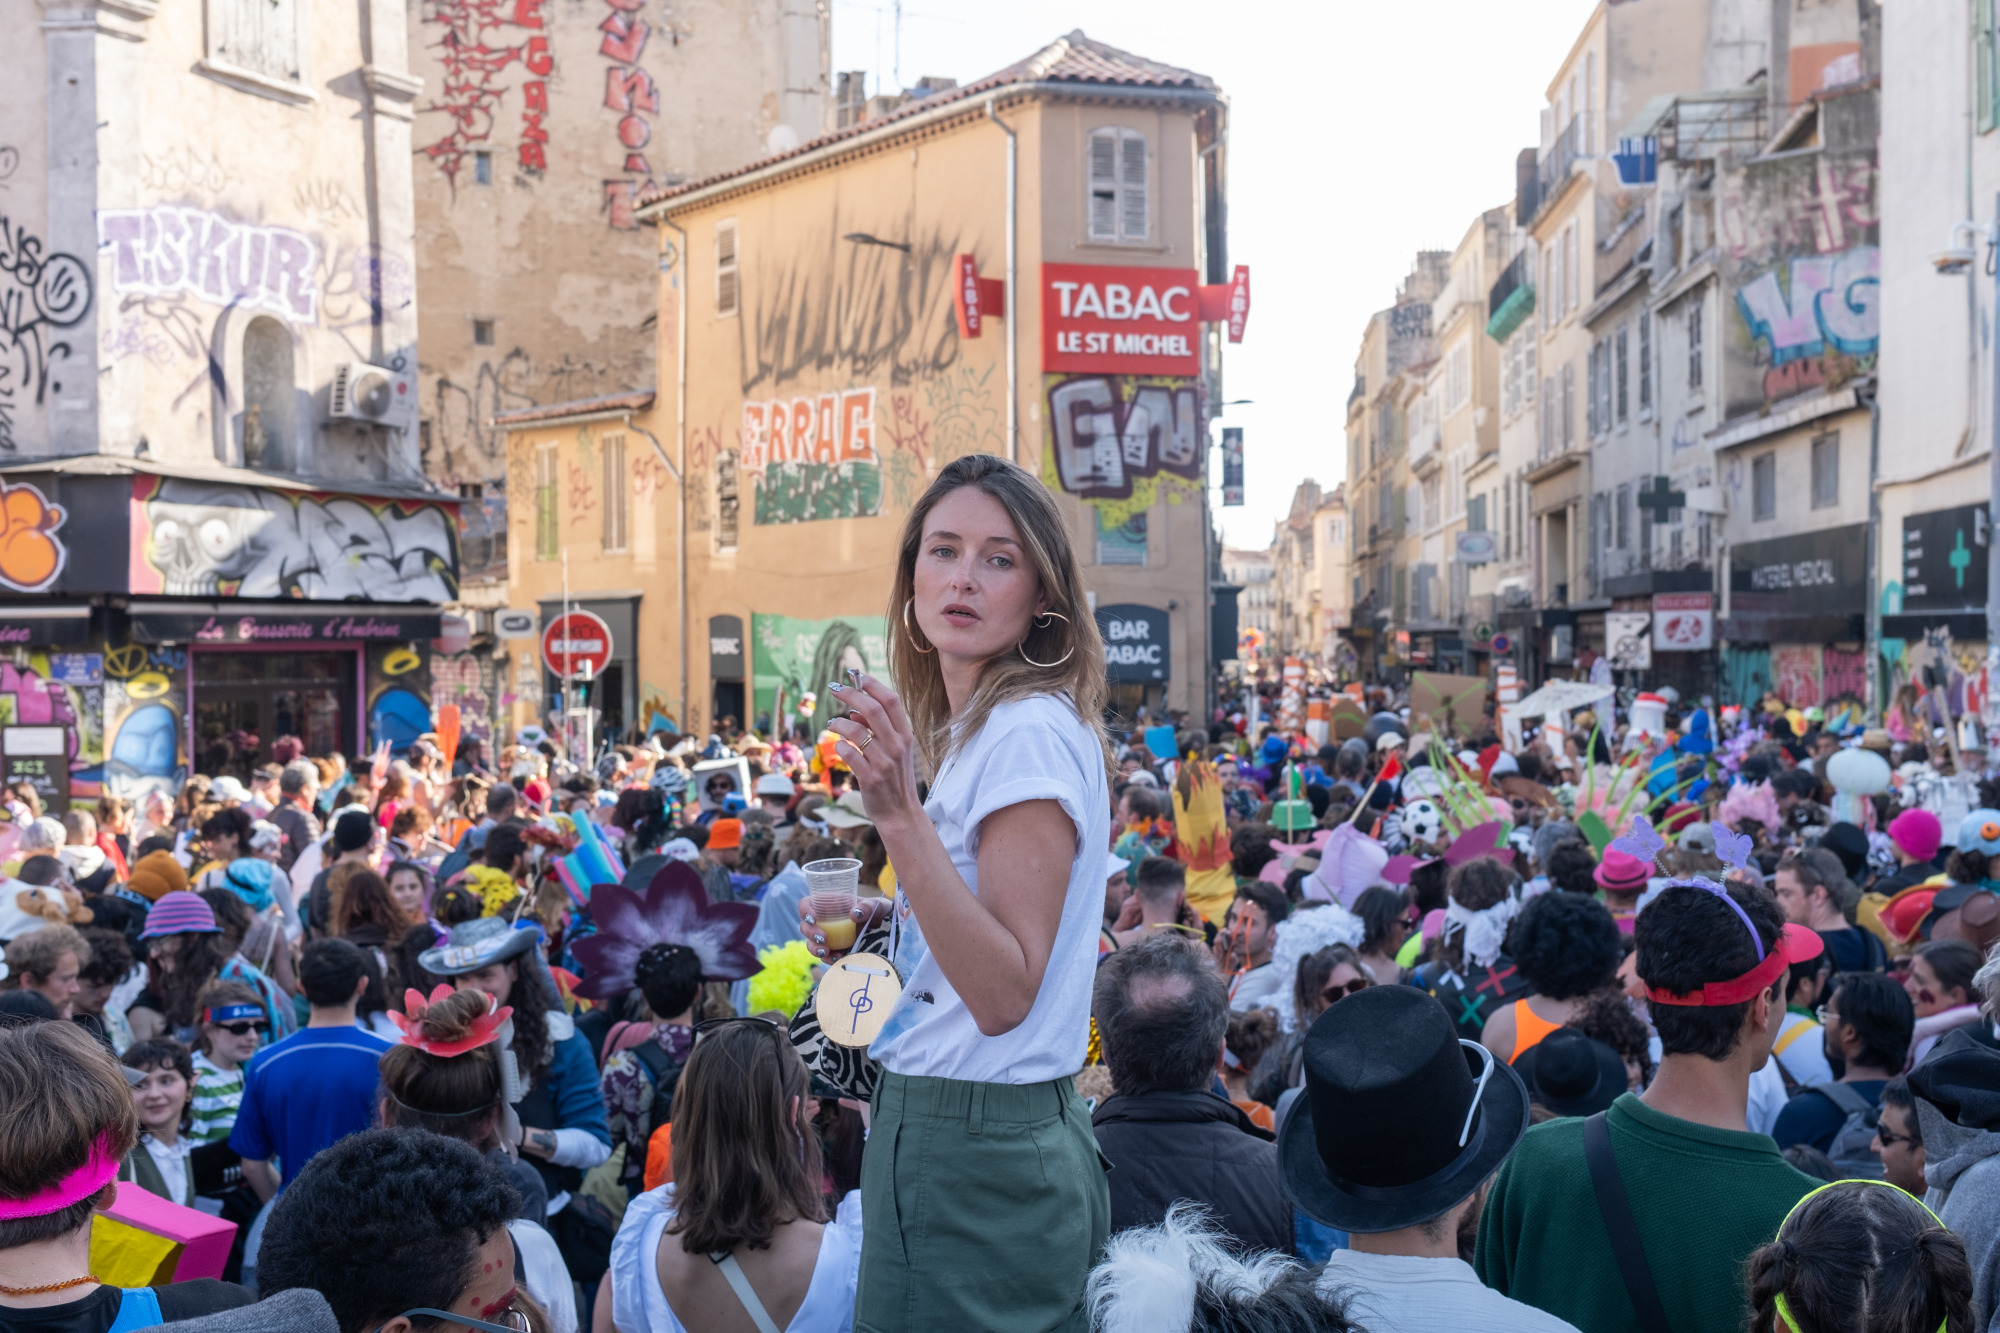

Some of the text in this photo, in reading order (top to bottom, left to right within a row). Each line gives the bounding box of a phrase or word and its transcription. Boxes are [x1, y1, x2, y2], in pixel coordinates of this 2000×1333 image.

[963, 262, 978, 329] TABAC
[1052, 281, 1191, 322] TABAC
[1230, 272, 1247, 336] TABAC
[1056, 331, 1193, 356] LE ST MICHEL
[195, 616, 401, 640] La Brasserie d'Ambrine
[1109, 620, 1150, 640] BAR
